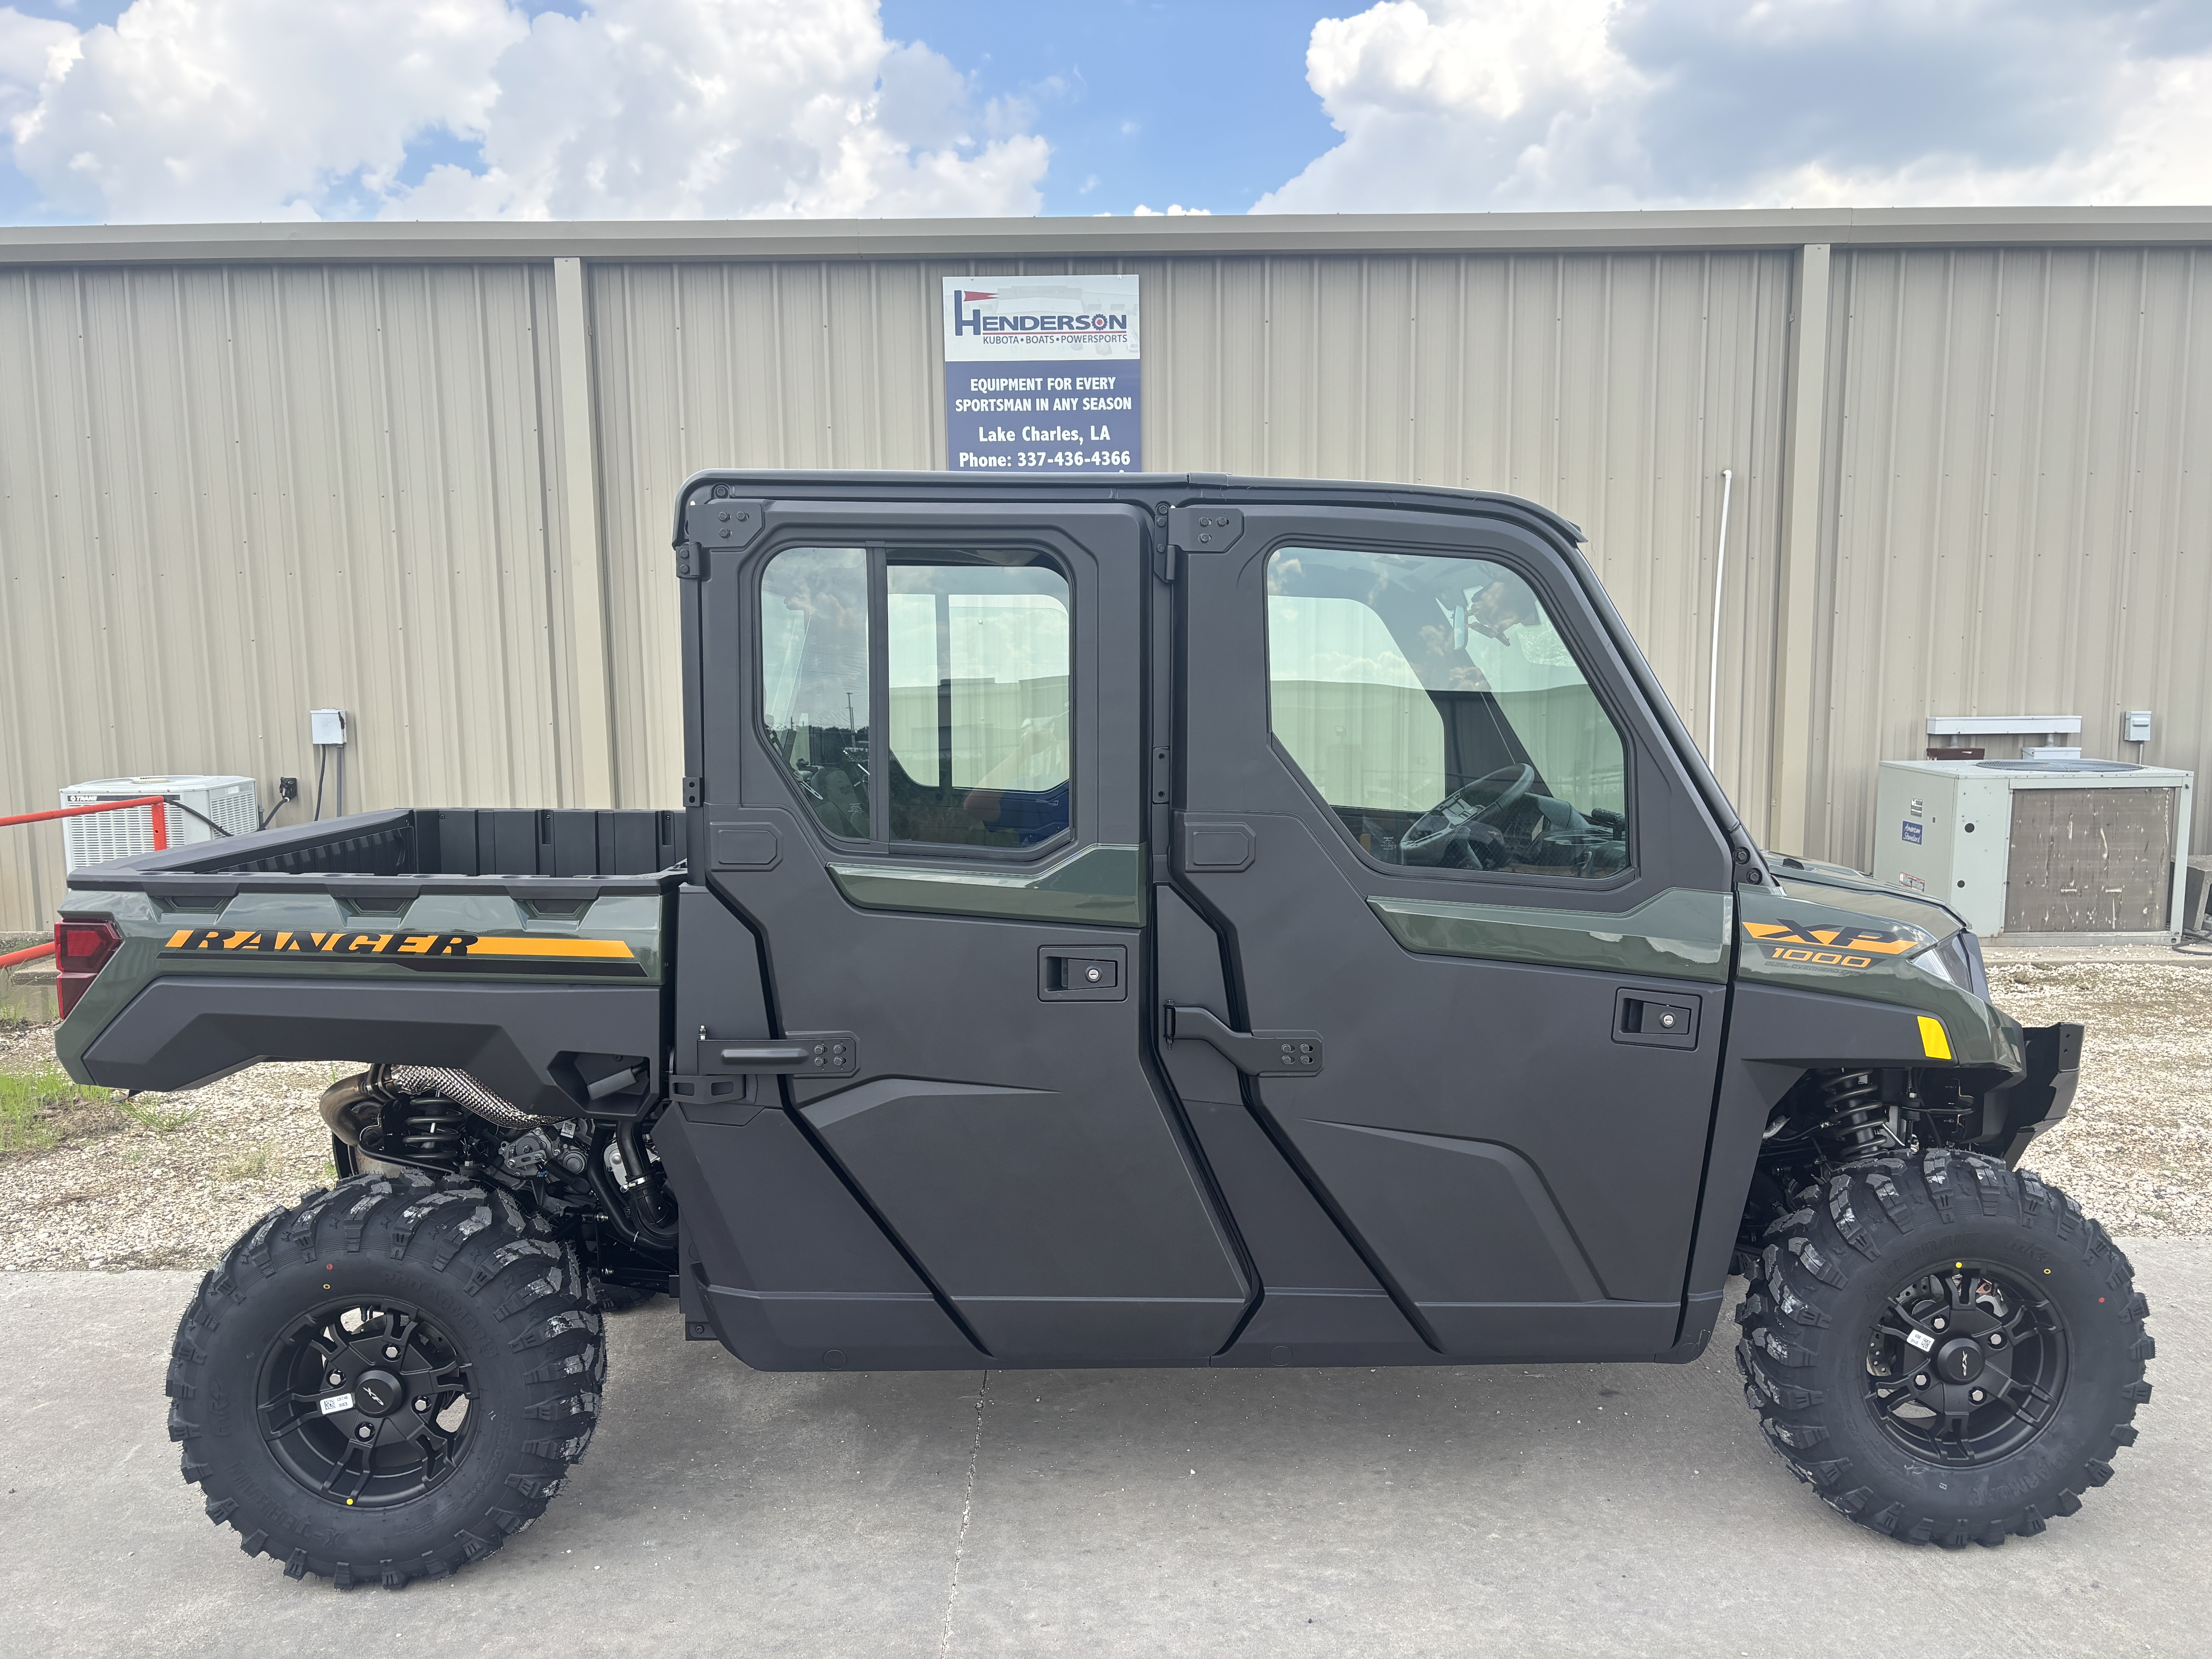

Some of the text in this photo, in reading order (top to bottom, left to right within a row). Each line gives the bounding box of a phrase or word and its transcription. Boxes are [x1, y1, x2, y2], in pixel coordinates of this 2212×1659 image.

[954, 290, 1127, 336] HENDERSON
[983, 335, 1128, 345] KUBOTA BOATS POWERSPORTS
[970, 377, 1116, 394] EQUIPMENT FOR EVERY
[955, 397, 1132, 412] SPORTSMAN IN ANY SEASON
[979, 426, 1111, 445] Lake Charles, LA
[959, 451, 1130, 467] Phone: 337-436-4366
[1903, 832, 1921, 843] Standard
[1904, 823, 1921, 834] American
[1757, 918, 1899, 946] XP
[180, 928, 479, 957] RANGER
[1772, 948, 1871, 968] 1000
[1962, 1350, 1968, 1376] XP
[362, 1387, 384, 1406] XP
